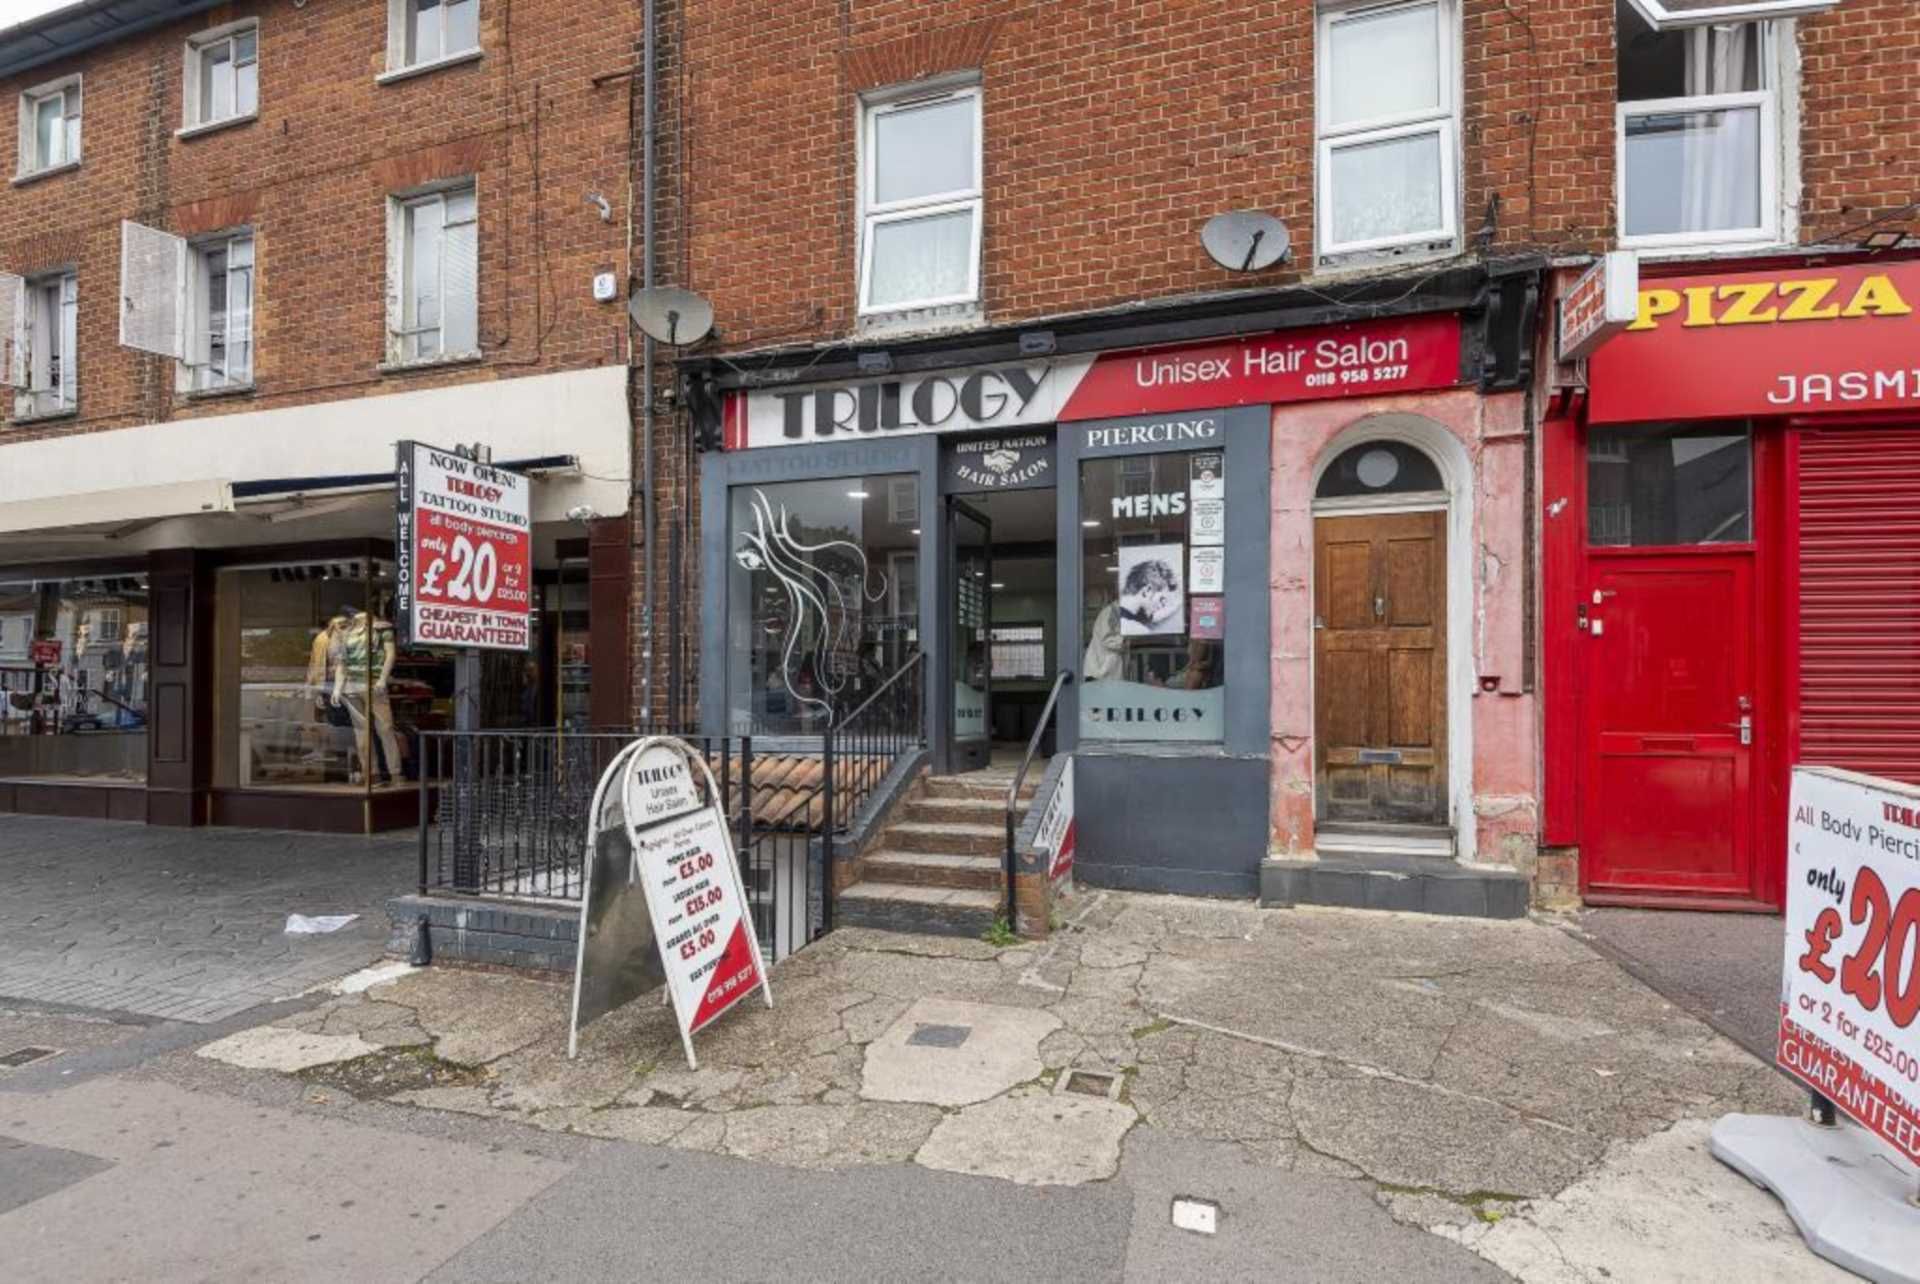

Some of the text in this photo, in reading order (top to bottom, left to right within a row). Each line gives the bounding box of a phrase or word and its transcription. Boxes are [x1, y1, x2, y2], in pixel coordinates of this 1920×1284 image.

[1626, 273, 1912, 331] PIZZA
[1136, 337, 1408, 387] Unisex Hair Salon
[1305, 365, 1409, 387] 0118 958 5277
[773, 365, 1051, 439] TRILOGY
[956, 435, 1047, 454] UNITED NATION
[1087, 418, 1216, 448] PIERCING
[400, 460, 409, 503] ALL
[429, 452, 517, 490] NOW OPEN!
[957, 457, 1049, 487] HAIR SALON
[446, 475, 503, 504] TRILOGY
[1112, 491, 1187, 518] MENS
[419, 490, 528, 528] TATTOO STUDIO
[446, 516, 476, 536] body
[398, 511, 410, 611] WELCOME
[420, 534, 449, 557] only
[419, 534, 498, 603] £20
[419, 607, 479, 624] CHEAPEST
[481, 613, 493, 625] IN
[1795, 804, 1815, 827] All
[1821, 810, 1863, 843] Body
[680, 852, 713, 880] £5.00
[686, 885, 723, 917] £15.00
[1806, 865, 1846, 905] only
[680, 929, 716, 961] £5.00
[1799, 993, 1919, 1083] or 2 for £25.00
